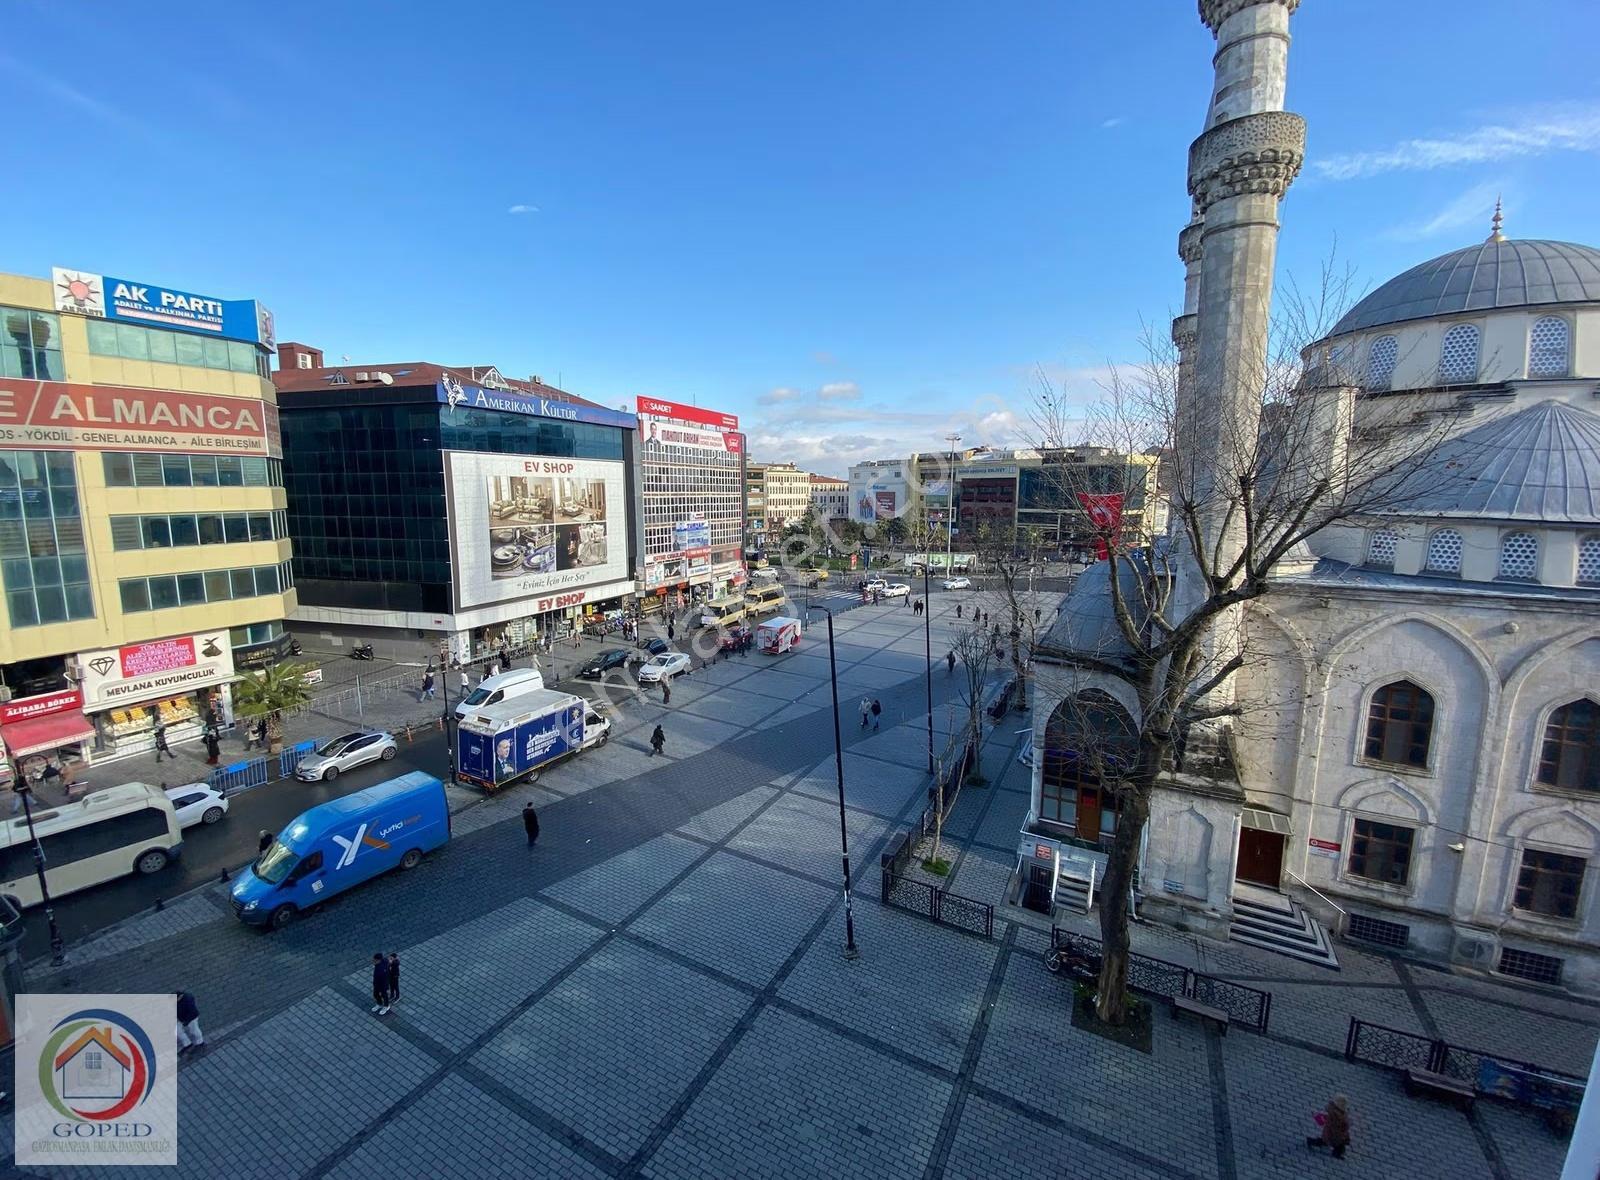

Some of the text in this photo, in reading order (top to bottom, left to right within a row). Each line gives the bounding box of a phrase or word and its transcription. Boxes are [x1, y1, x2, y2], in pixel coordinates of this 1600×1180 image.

[113, 283, 149, 303] AK
[114, 300, 142, 310] ADALET
[155, 306, 195, 318] KALKINMA
[50, 394, 260, 431] ALMANCA
[541, 401, 577, 420] KÜLTÜR
[649, 402, 672, 413] SAADET
[25, 428, 72, 441] YÖKDİL
[81, 432, 120, 443] GENEL
[123, 433, 177, 445] ALMANCA
[190, 436, 213, 447] AİLE
[215, 437, 262, 449] BİRLEŞİMİ
[525, 461, 574, 474] EV SHOP
[547, 573, 560, 588] İçin
[562, 574, 574, 584] Her
[537, 591, 585, 612] EV SHOP
[106, 668, 215, 697] MEVLANA KUYUMCULUK
[6, 703, 46, 717] ALİBABA
[47, 696, 77, 708] BÖREK
